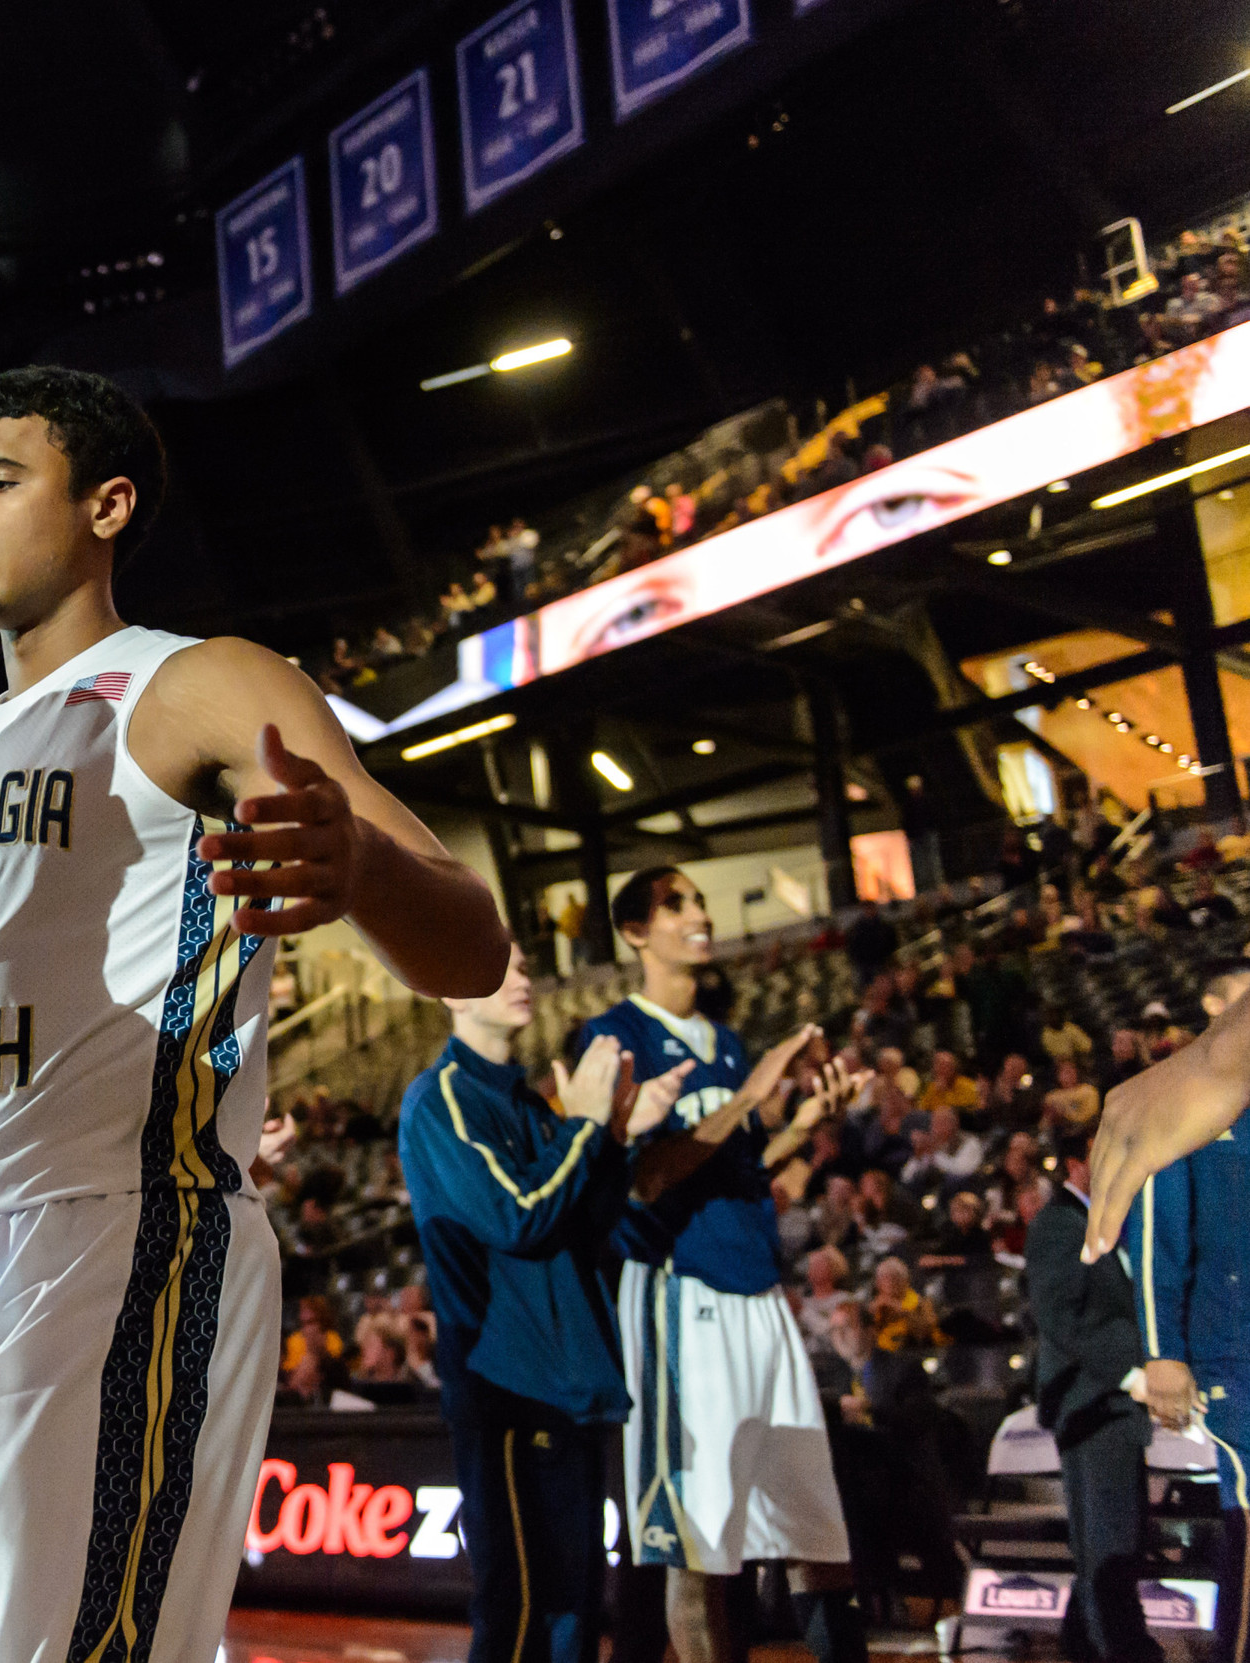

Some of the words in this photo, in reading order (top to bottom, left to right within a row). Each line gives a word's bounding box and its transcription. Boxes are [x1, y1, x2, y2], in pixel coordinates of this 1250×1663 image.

[495, 51, 538, 120] 21
[359, 142, 403, 209] 20
[246, 225, 279, 283] 15
[245, 1458, 414, 1559] Coke
